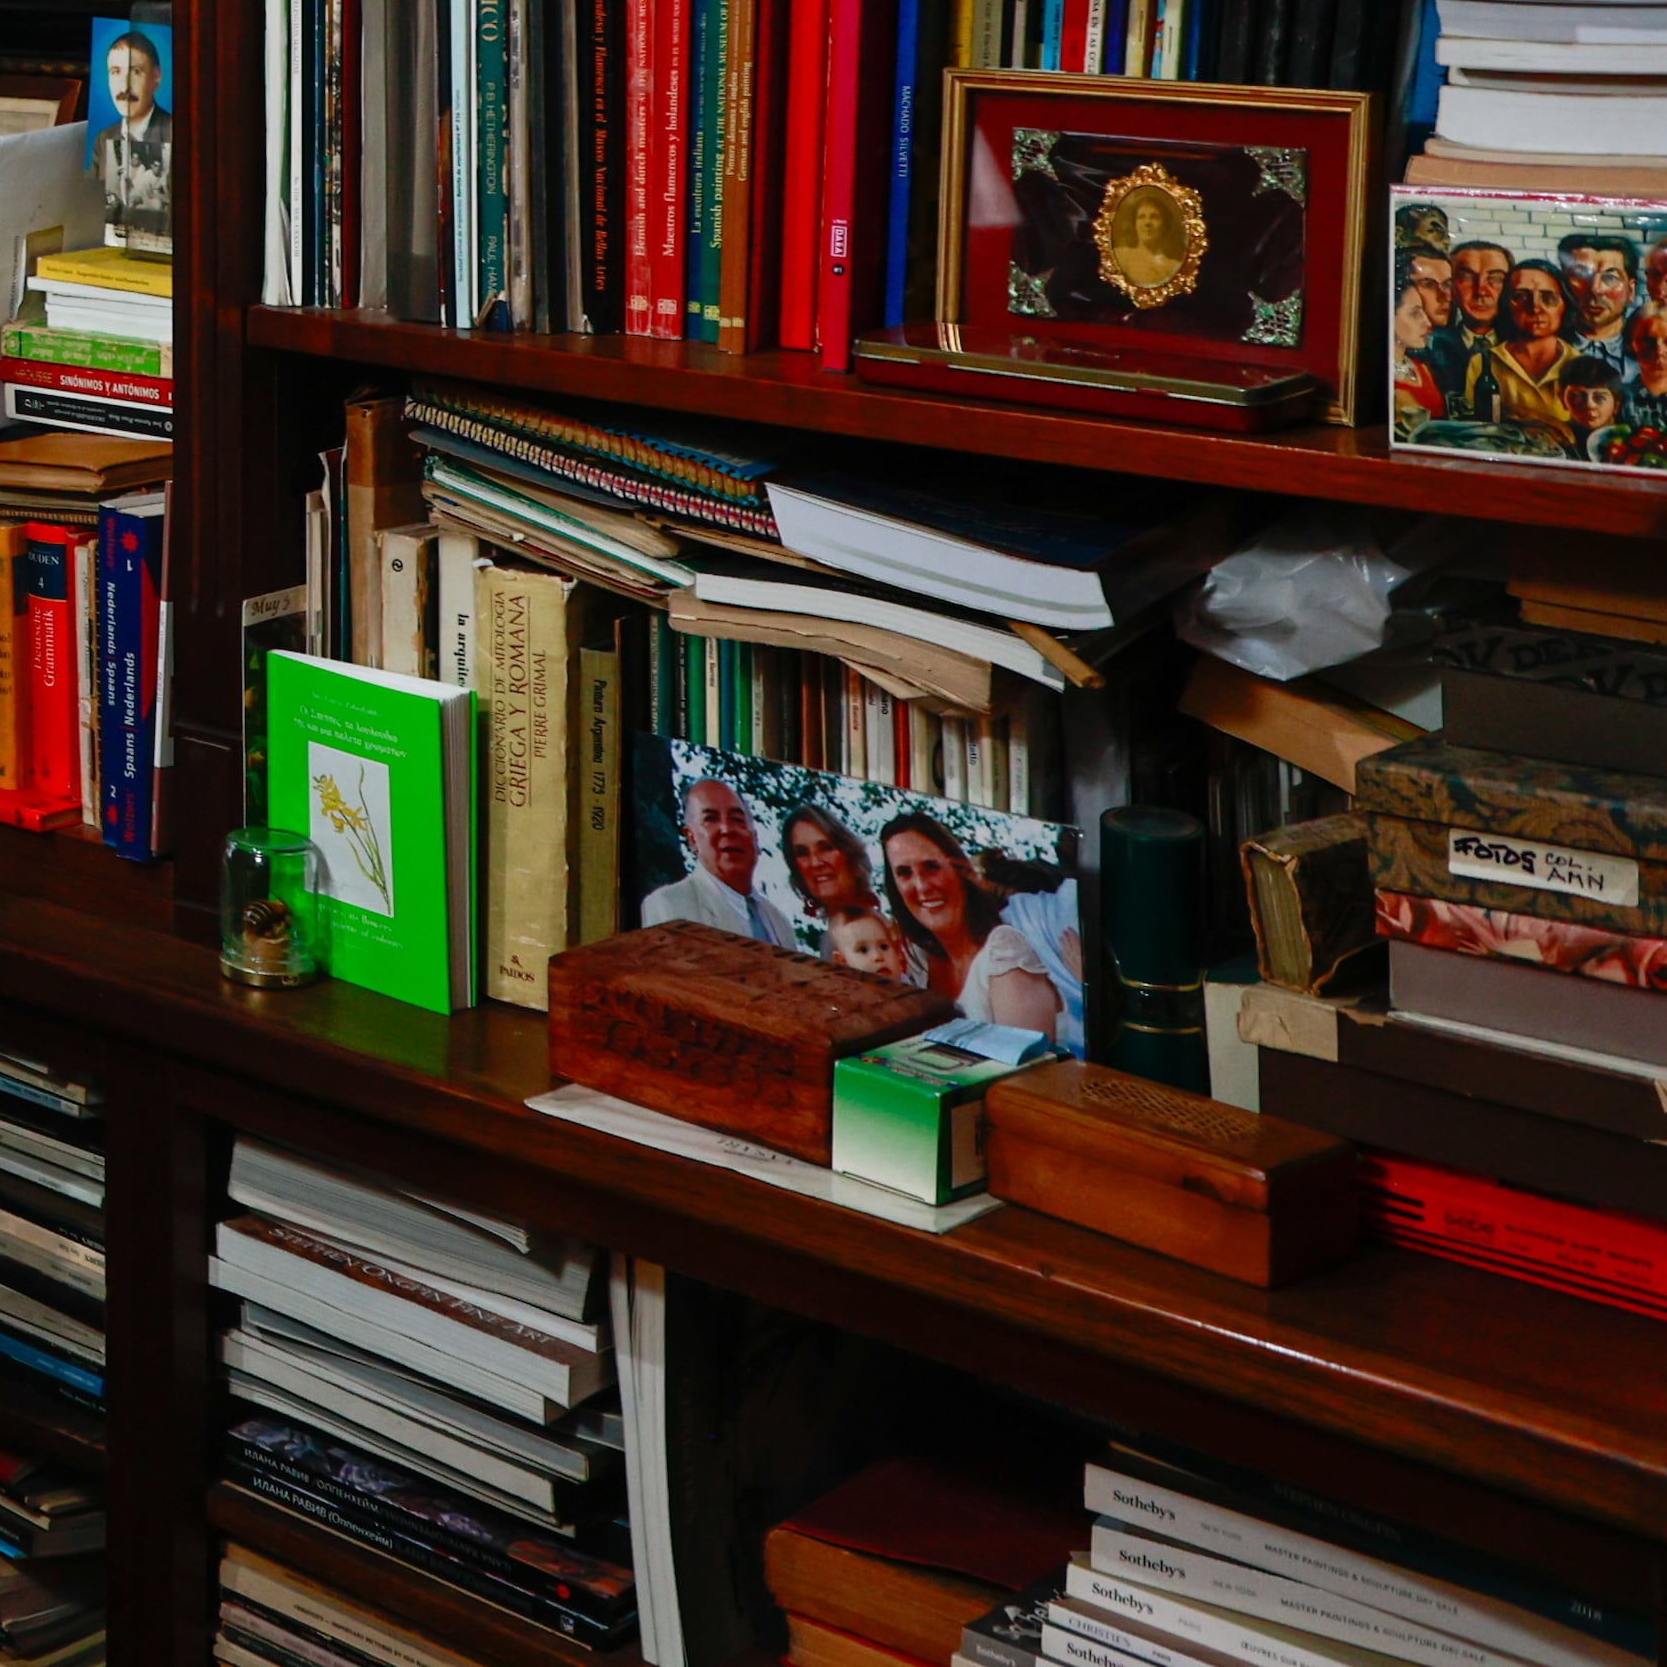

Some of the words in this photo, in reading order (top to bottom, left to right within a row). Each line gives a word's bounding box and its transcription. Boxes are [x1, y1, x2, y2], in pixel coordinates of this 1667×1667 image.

[717, 21, 728, 62] MUSEUM
[1091, 16, 1101, 30] EN
[593, 46, 607, 94] Flamenca
[715, 66, 727, 112] NATIONAL
[728, 71, 740, 99] inglesa
[740, 61, 752, 96] painting
[665, 68, 679, 130] holandeses
[739, 98, 750, 127] english
[899, 85, 912, 133] MACHADO
[593, 128, 607, 159] Museo
[726, 108, 738, 142] alemana
[738, 130, 749, 147] and
[485, 104, 496, 194] HETHERINGTON
[692, 130, 704, 168] italiana
[724, 144, 736, 175] Pintura
[737, 149, 749, 180] German
[897, 136, 910, 178] SILVETTI
[594, 162, 608, 215] Nacional
[663, 143, 677, 201] flamencos
[711, 152, 726, 200] painting
[691, 171, 703, 217] escultura
[594, 230, 608, 261] Bellas
[662, 205, 676, 256] Maestros
[690, 221, 701, 233] La
[709, 204, 724, 248] Spanish
[486, 234, 498, 263] PAUL
[594, 264, 608, 292] Artes
[59, 373, 104, 394] SINÓNIMOS
[105, 382, 111, 396] Y
[112, 381, 161, 400] ANTÓNIMOS
[37, 576, 45, 589] 4
[31, 603, 45, 670] Deutsche
[106, 581, 117, 655] Nederlands
[457, 614, 469, 627] la
[41, 609, 56, 688] Grammatik
[508, 594, 527, 696] ROMANA
[105, 660, 117, 707] Spaans
[122, 651, 137, 726] Nederlands
[494, 677, 508, 694] DE
[531, 648, 550, 707] GRIMAL
[591, 678, 606, 713] Pintura
[508, 702, 527, 716] Y
[494, 699, 508, 802] DICCIONARIO
[532, 710, 549, 758] PIERRE
[122, 732, 138, 779] Spaans
[508, 725, 528, 807] GRIEGA
[592, 770, 605, 795] 1775
[591, 805, 604, 831] 1920
[251, 1477, 292, 1501] ИЛАНА
[291, 1493, 329, 1518] РАВИВ
[1110, 1488, 1179, 1522] Sotheby's
[1117, 1550, 1189, 1581] Sotheby's
[1090, 1582, 1157, 1618] Sotheby's
[1320, 1608, 1371, 1630] PAINTINGS
[1382, 1627, 1441, 1651] SCULPTURE
[1443, 1645, 1461, 1657] DAY
[1463, 1651, 1487, 1665] SALE
